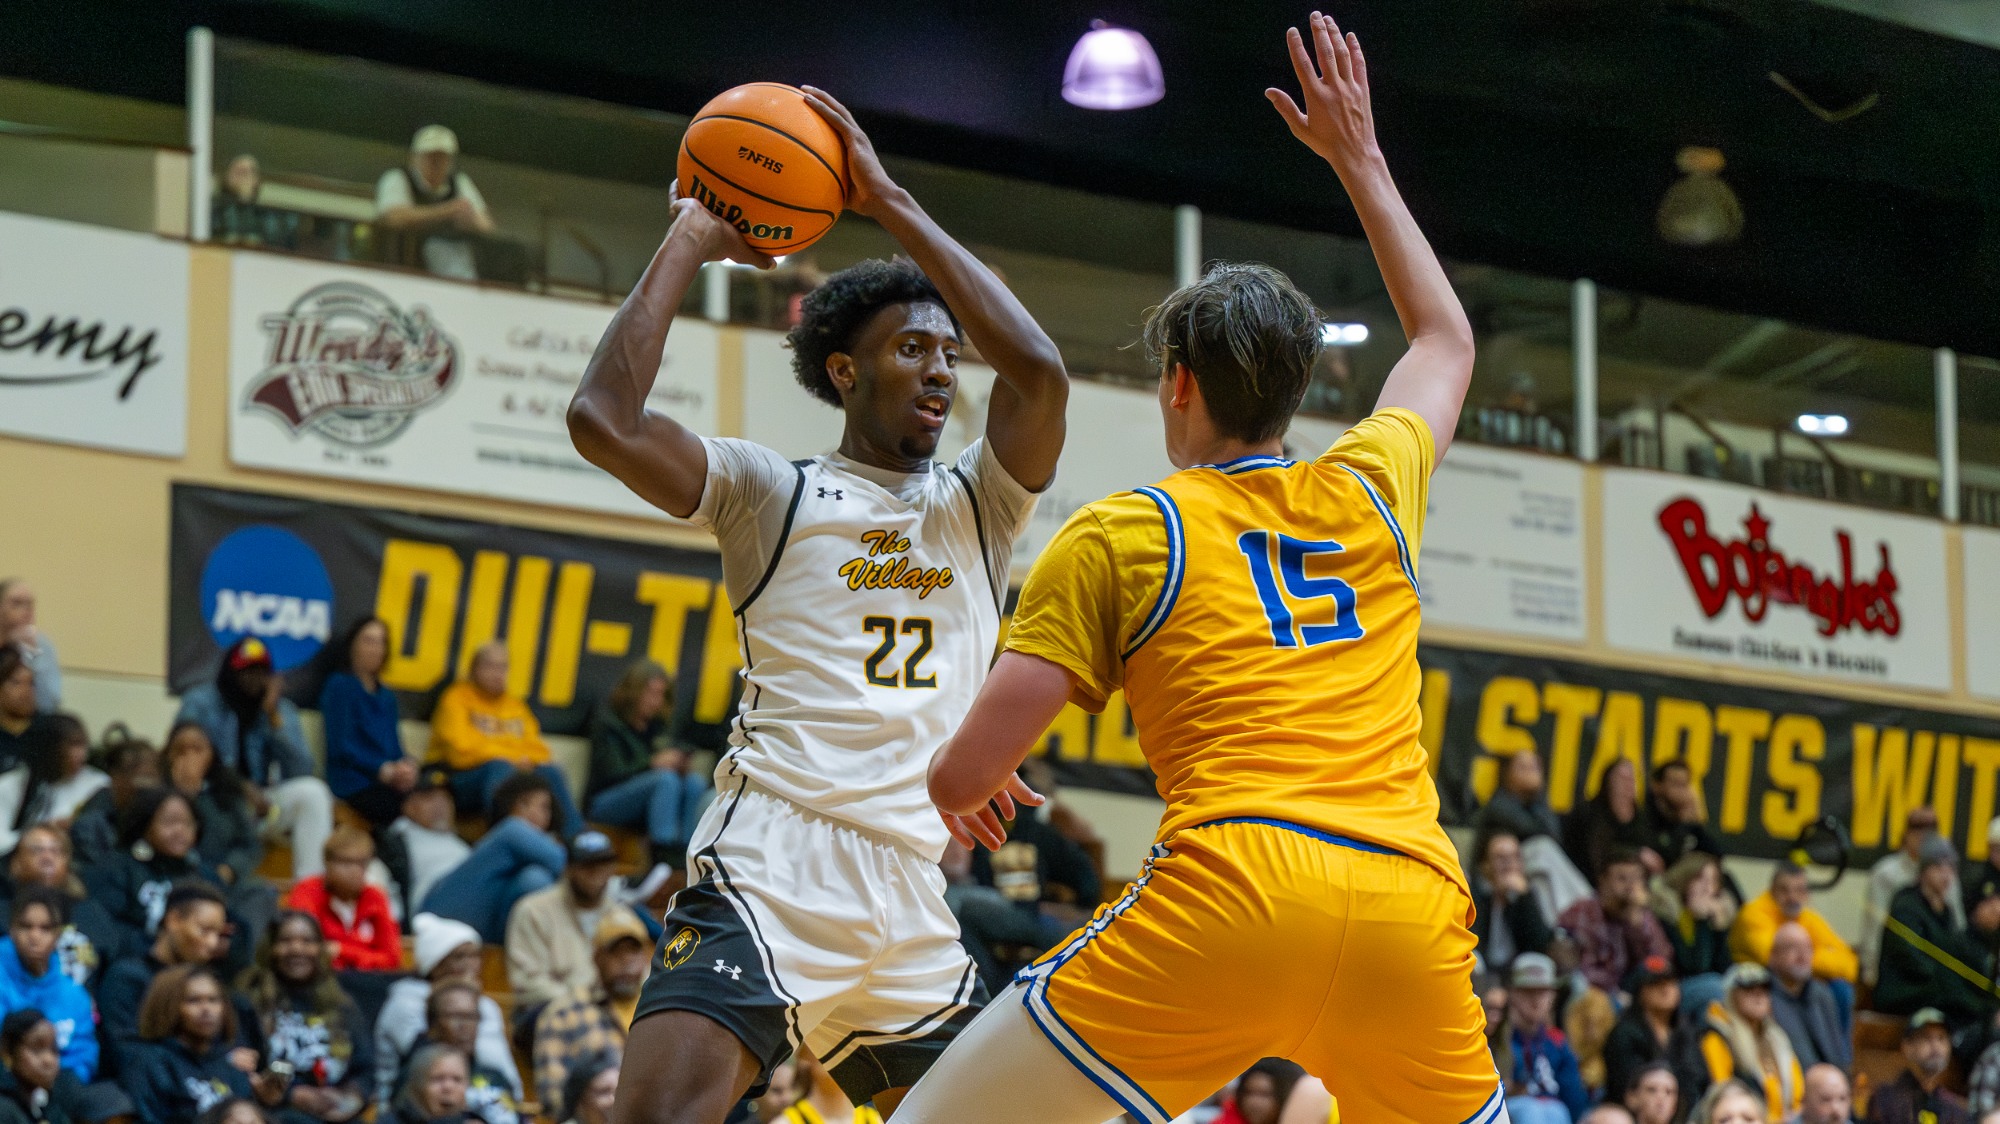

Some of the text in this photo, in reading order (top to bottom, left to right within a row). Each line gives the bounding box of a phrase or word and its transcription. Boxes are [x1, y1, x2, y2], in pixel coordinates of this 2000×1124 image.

[747, 149, 784, 175] NFHS
[860, 529, 911, 558] The
[838, 556, 955, 601] Village
[1236, 529, 1367, 649] 15
[212, 587, 332, 644] NCAA
[862, 614, 939, 689] 22
[1470, 676, 1827, 842] STARTS
